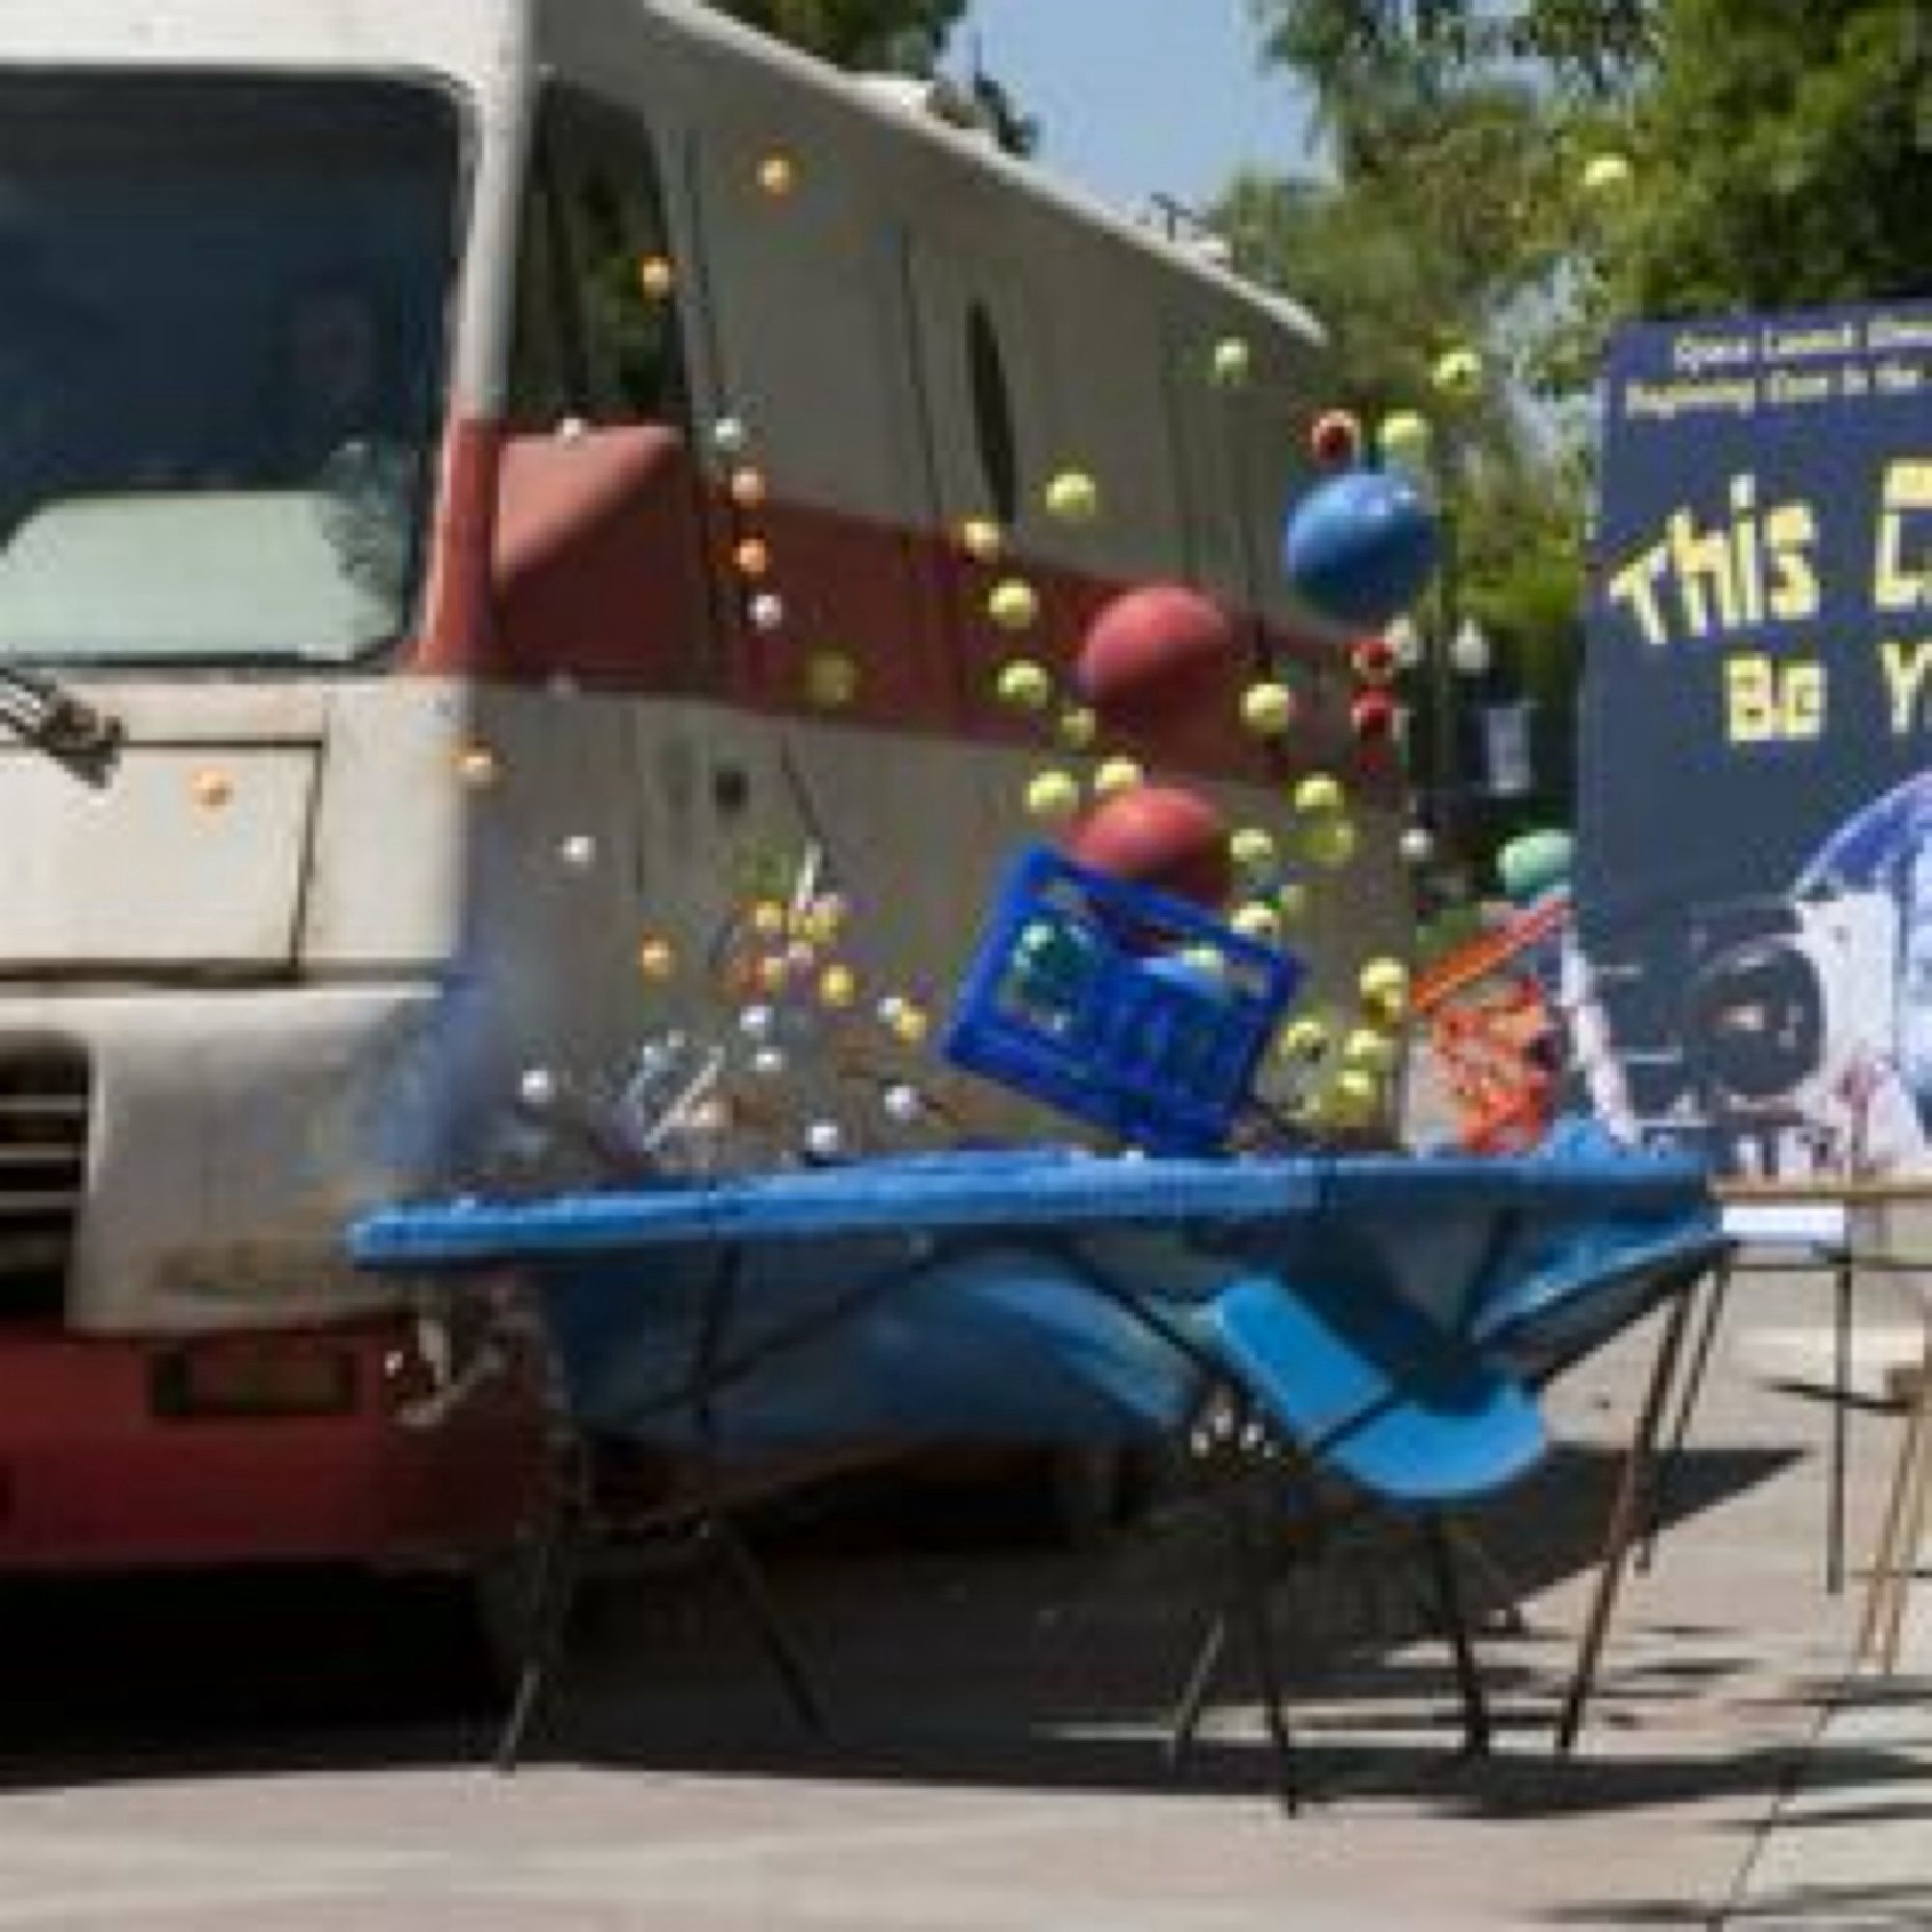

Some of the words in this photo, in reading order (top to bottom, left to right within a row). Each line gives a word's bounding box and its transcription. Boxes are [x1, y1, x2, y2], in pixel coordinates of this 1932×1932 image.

[1608, 474, 1820, 644] This
[1724, 653, 1826, 742] Be
[1878, 641, 1932, 734] Y
